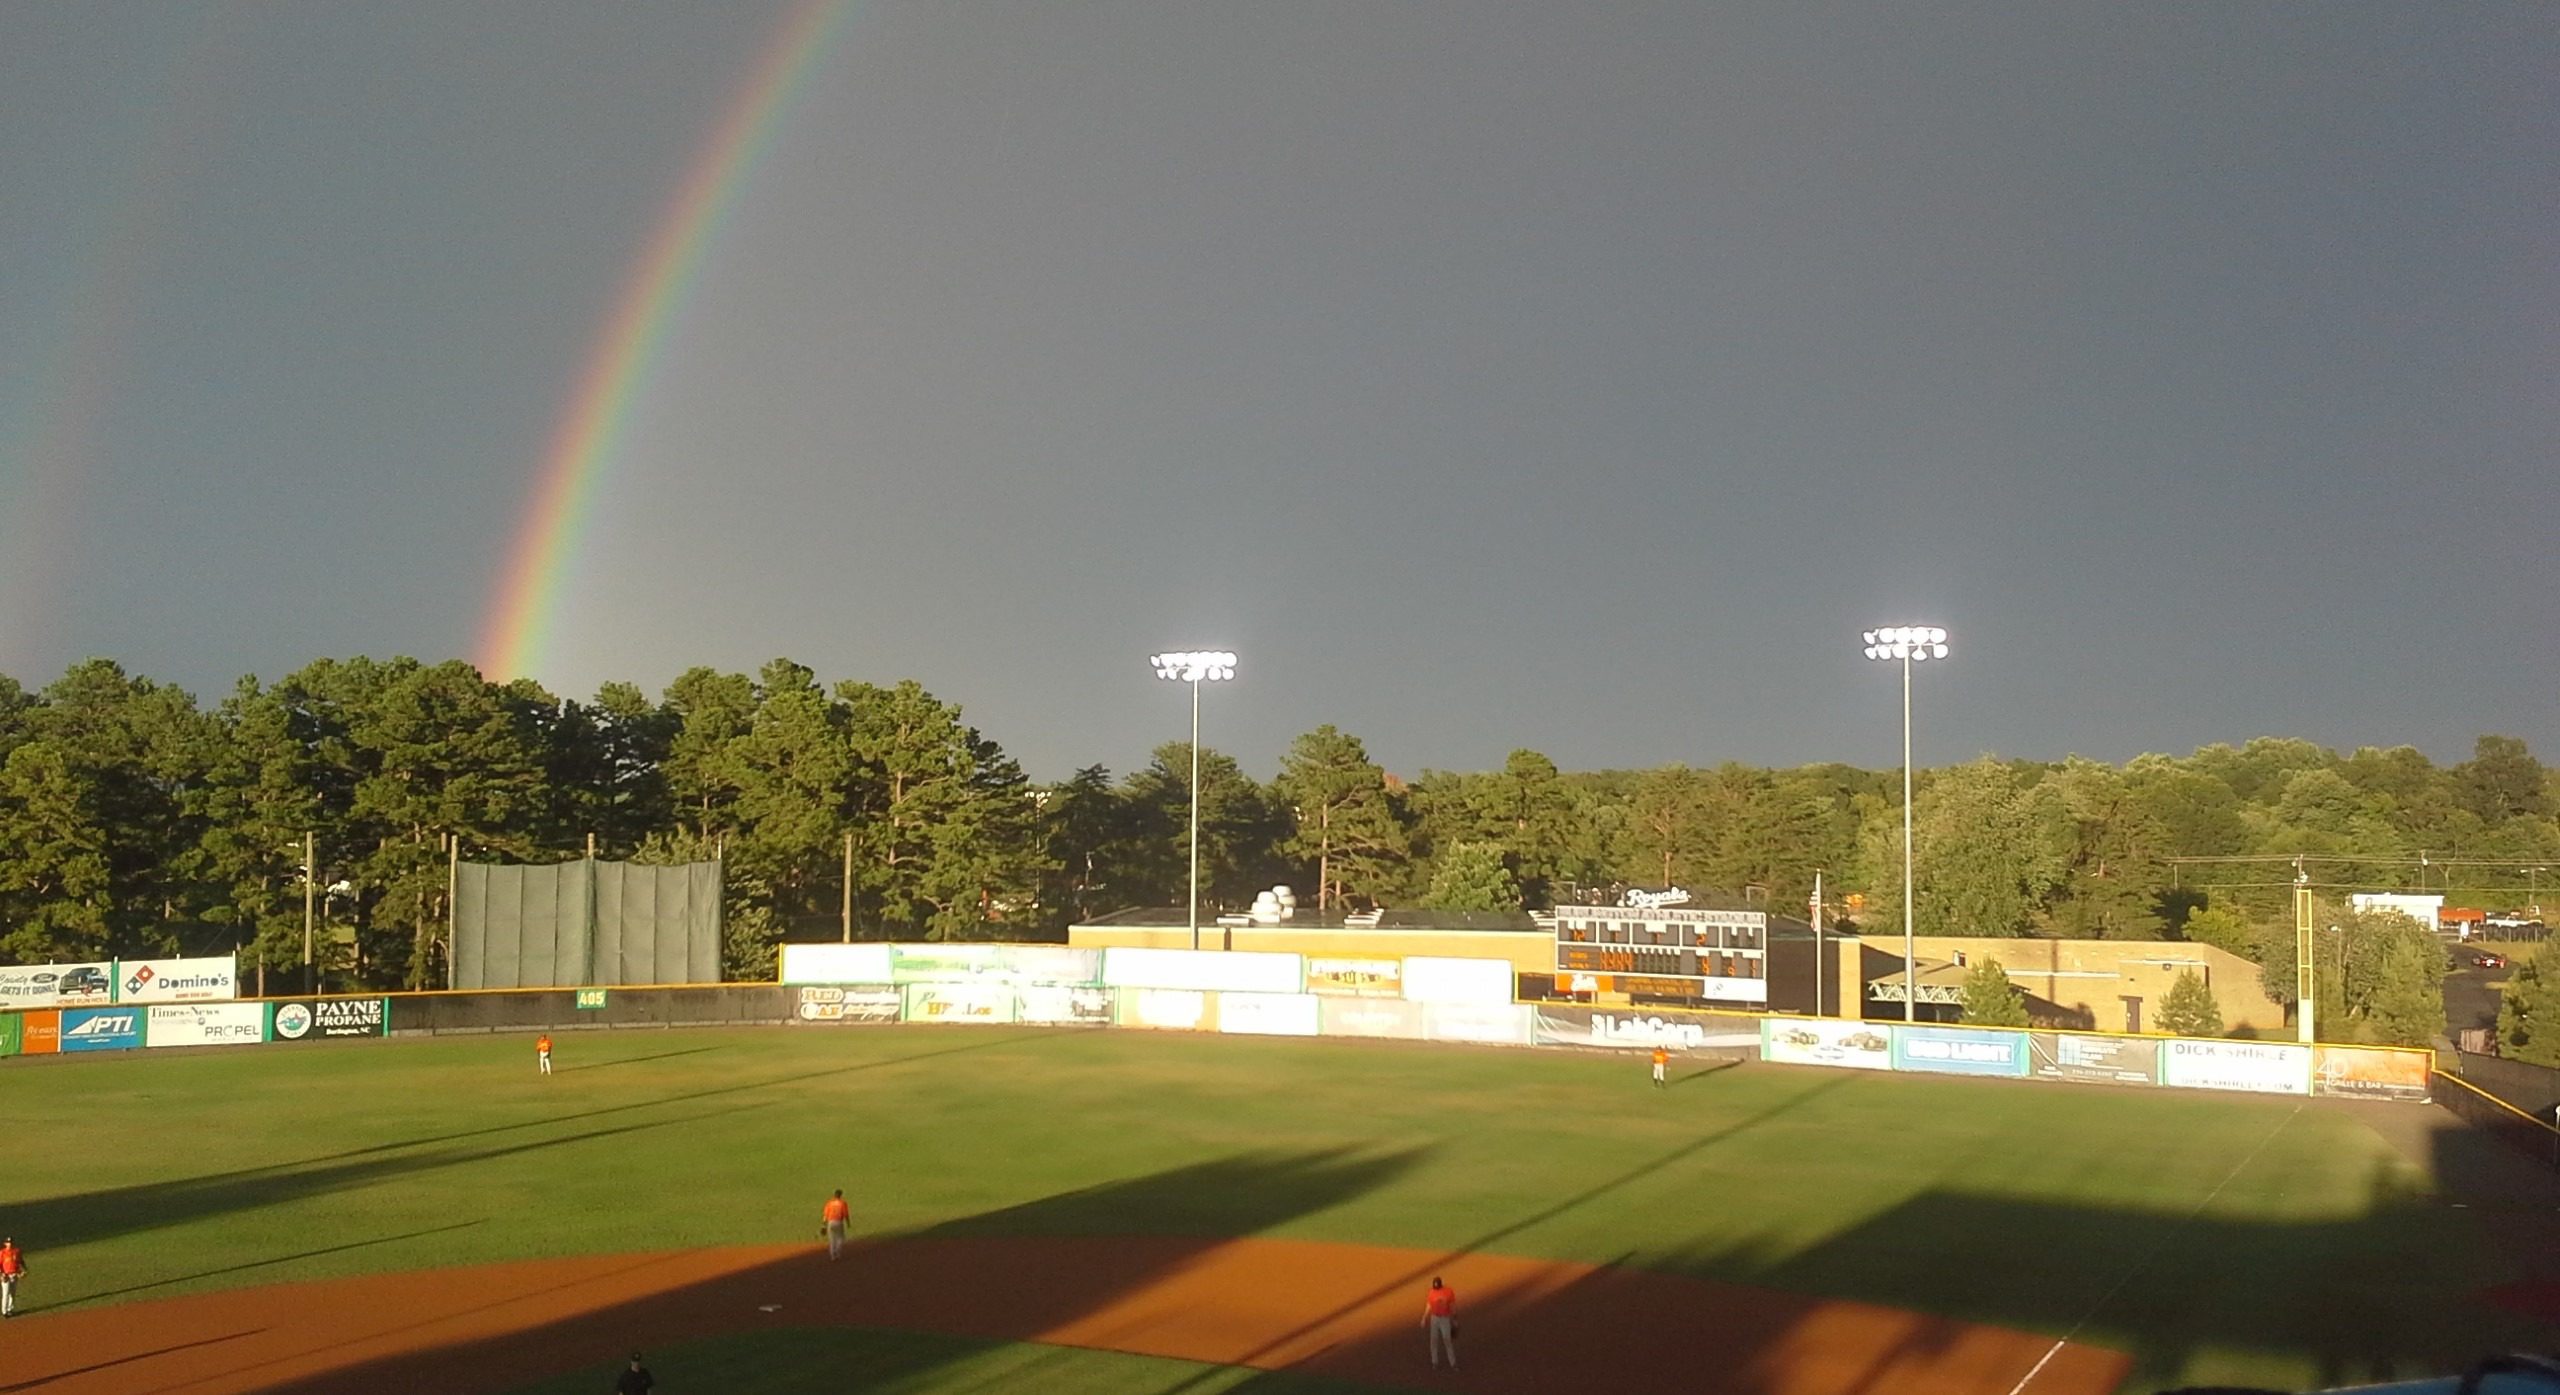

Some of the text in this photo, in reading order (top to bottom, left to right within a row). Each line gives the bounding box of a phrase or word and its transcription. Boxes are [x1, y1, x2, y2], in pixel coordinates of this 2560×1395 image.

[1626, 886, 1689, 909] Royals
[158, 974, 229, 989] Domino's
[152, 1006, 220, 1018] Times-News
[316, 1000, 382, 1016] PAYNE
[315, 1014, 382, 1027] PROPANE
[1606, 1014, 1704, 1048] LabCorp
[2175, 1043, 2216, 1056] DICK
